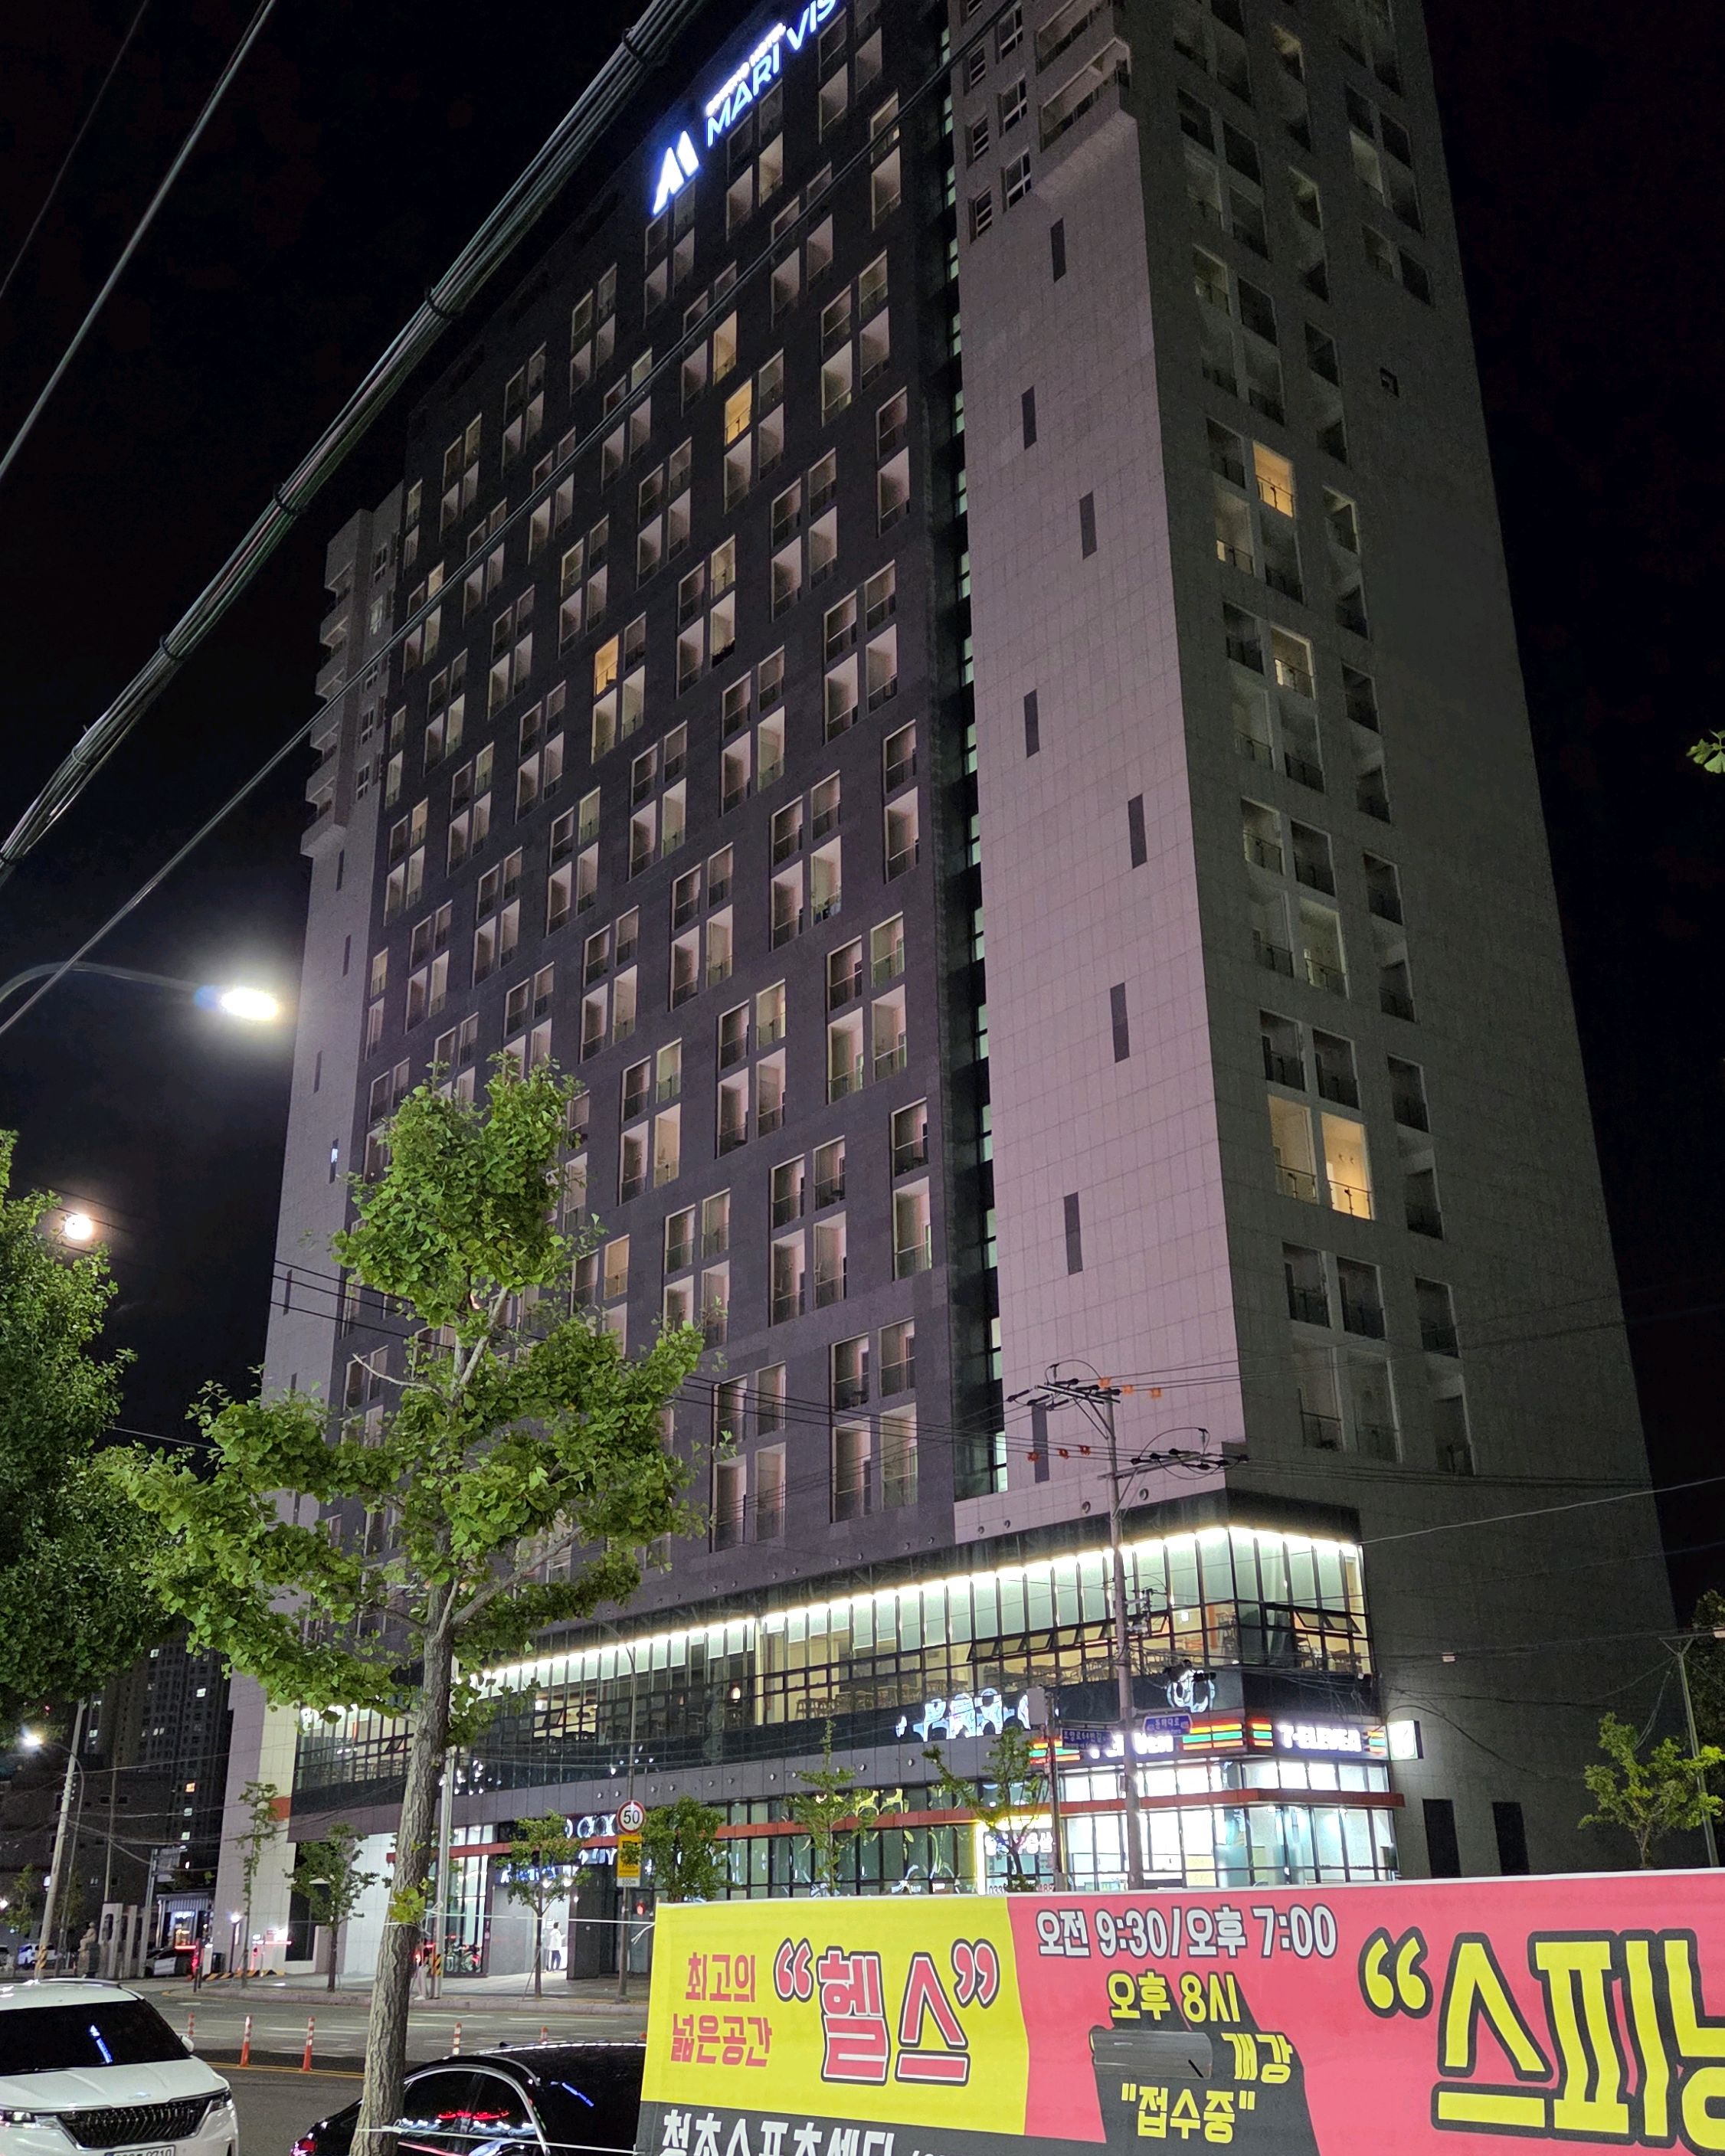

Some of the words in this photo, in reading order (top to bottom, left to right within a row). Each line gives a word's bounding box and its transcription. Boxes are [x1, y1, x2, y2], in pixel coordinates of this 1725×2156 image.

[707, 42, 780, 148] MARI
[623, 1810, 640, 1824] 50
[1037, 1909, 1091, 1957] 오전
[1095, 1906, 1247, 1958] 9:30/오후
[1252, 1905, 1337, 1958] 7:00
[685, 1952, 756, 2003] 최고의
[1108, 1971, 1171, 2020] 오후
[1180, 1974, 1241, 2023] 8시
[670, 2013, 773, 2067] 넓은공간
[1221, 2032, 1294, 2084] 개강
[1121, 2082, 1256, 2144] "접수중"
